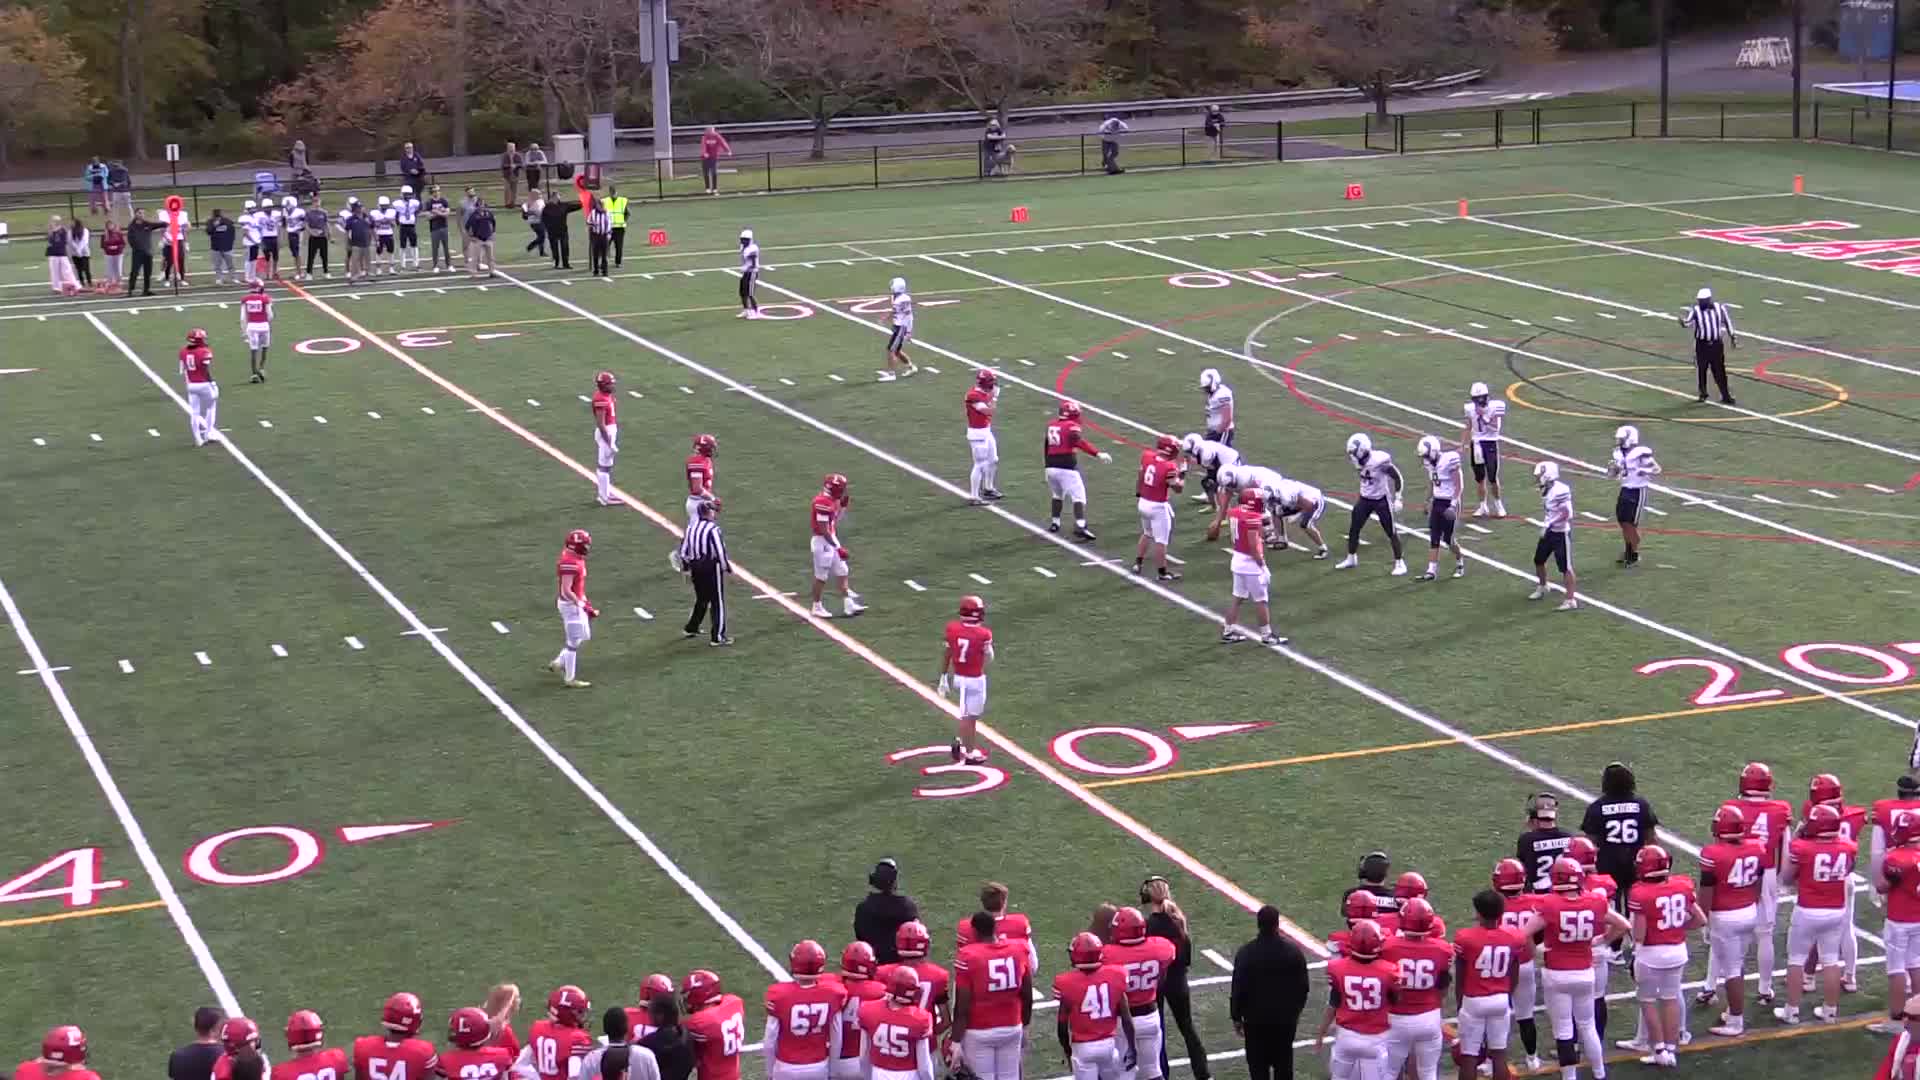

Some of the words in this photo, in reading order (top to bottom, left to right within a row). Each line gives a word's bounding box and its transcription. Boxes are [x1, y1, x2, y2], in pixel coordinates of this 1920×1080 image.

[1144, 464, 1156, 486] 6
[957, 637, 970, 663] 7
[1634, 641, 1917, 706] 20
[885, 724, 1181, 798] 30
[1605, 818, 1639, 844] 26
[0, 824, 326, 907] 40
[1727, 855, 1760, 888] 42
[1813, 852, 1848, 882] 64
[1559, 910, 1595, 943] 56
[1655, 892, 1687, 931] 38
[988, 956, 1018, 992] 51
[1126, 960, 1160, 992] 52
[1475, 945, 1511, 979] 40
[1079, 982, 1112, 1020] 41
[1344, 975, 1382, 1011] 53
[790, 1002, 830, 1036] 67
[536, 1035, 558, 1076] 18
[872, 1022, 910, 1058] 45
[368, 1057, 407, 1080] 54
